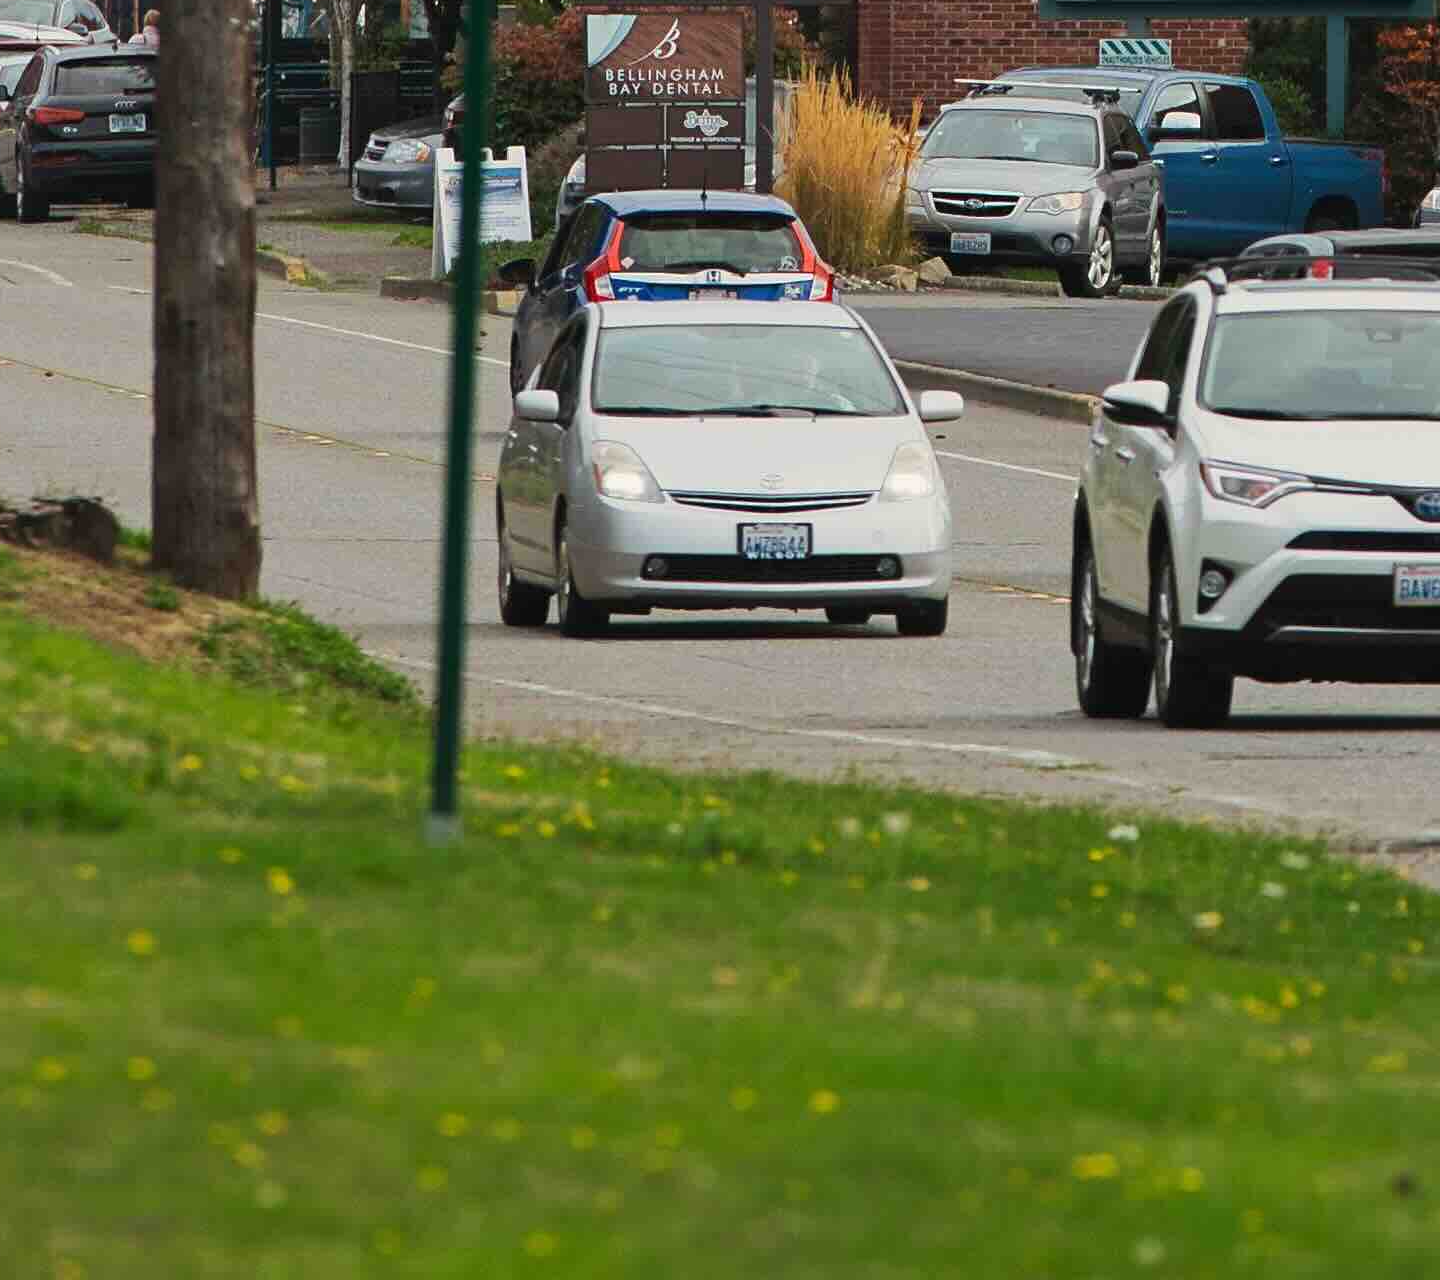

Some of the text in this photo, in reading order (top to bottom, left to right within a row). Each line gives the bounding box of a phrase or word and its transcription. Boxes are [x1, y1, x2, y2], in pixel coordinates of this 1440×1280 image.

[606, 69, 724, 82] BELLINGHAM
[609, 82, 721, 95] BAY DENTAL
